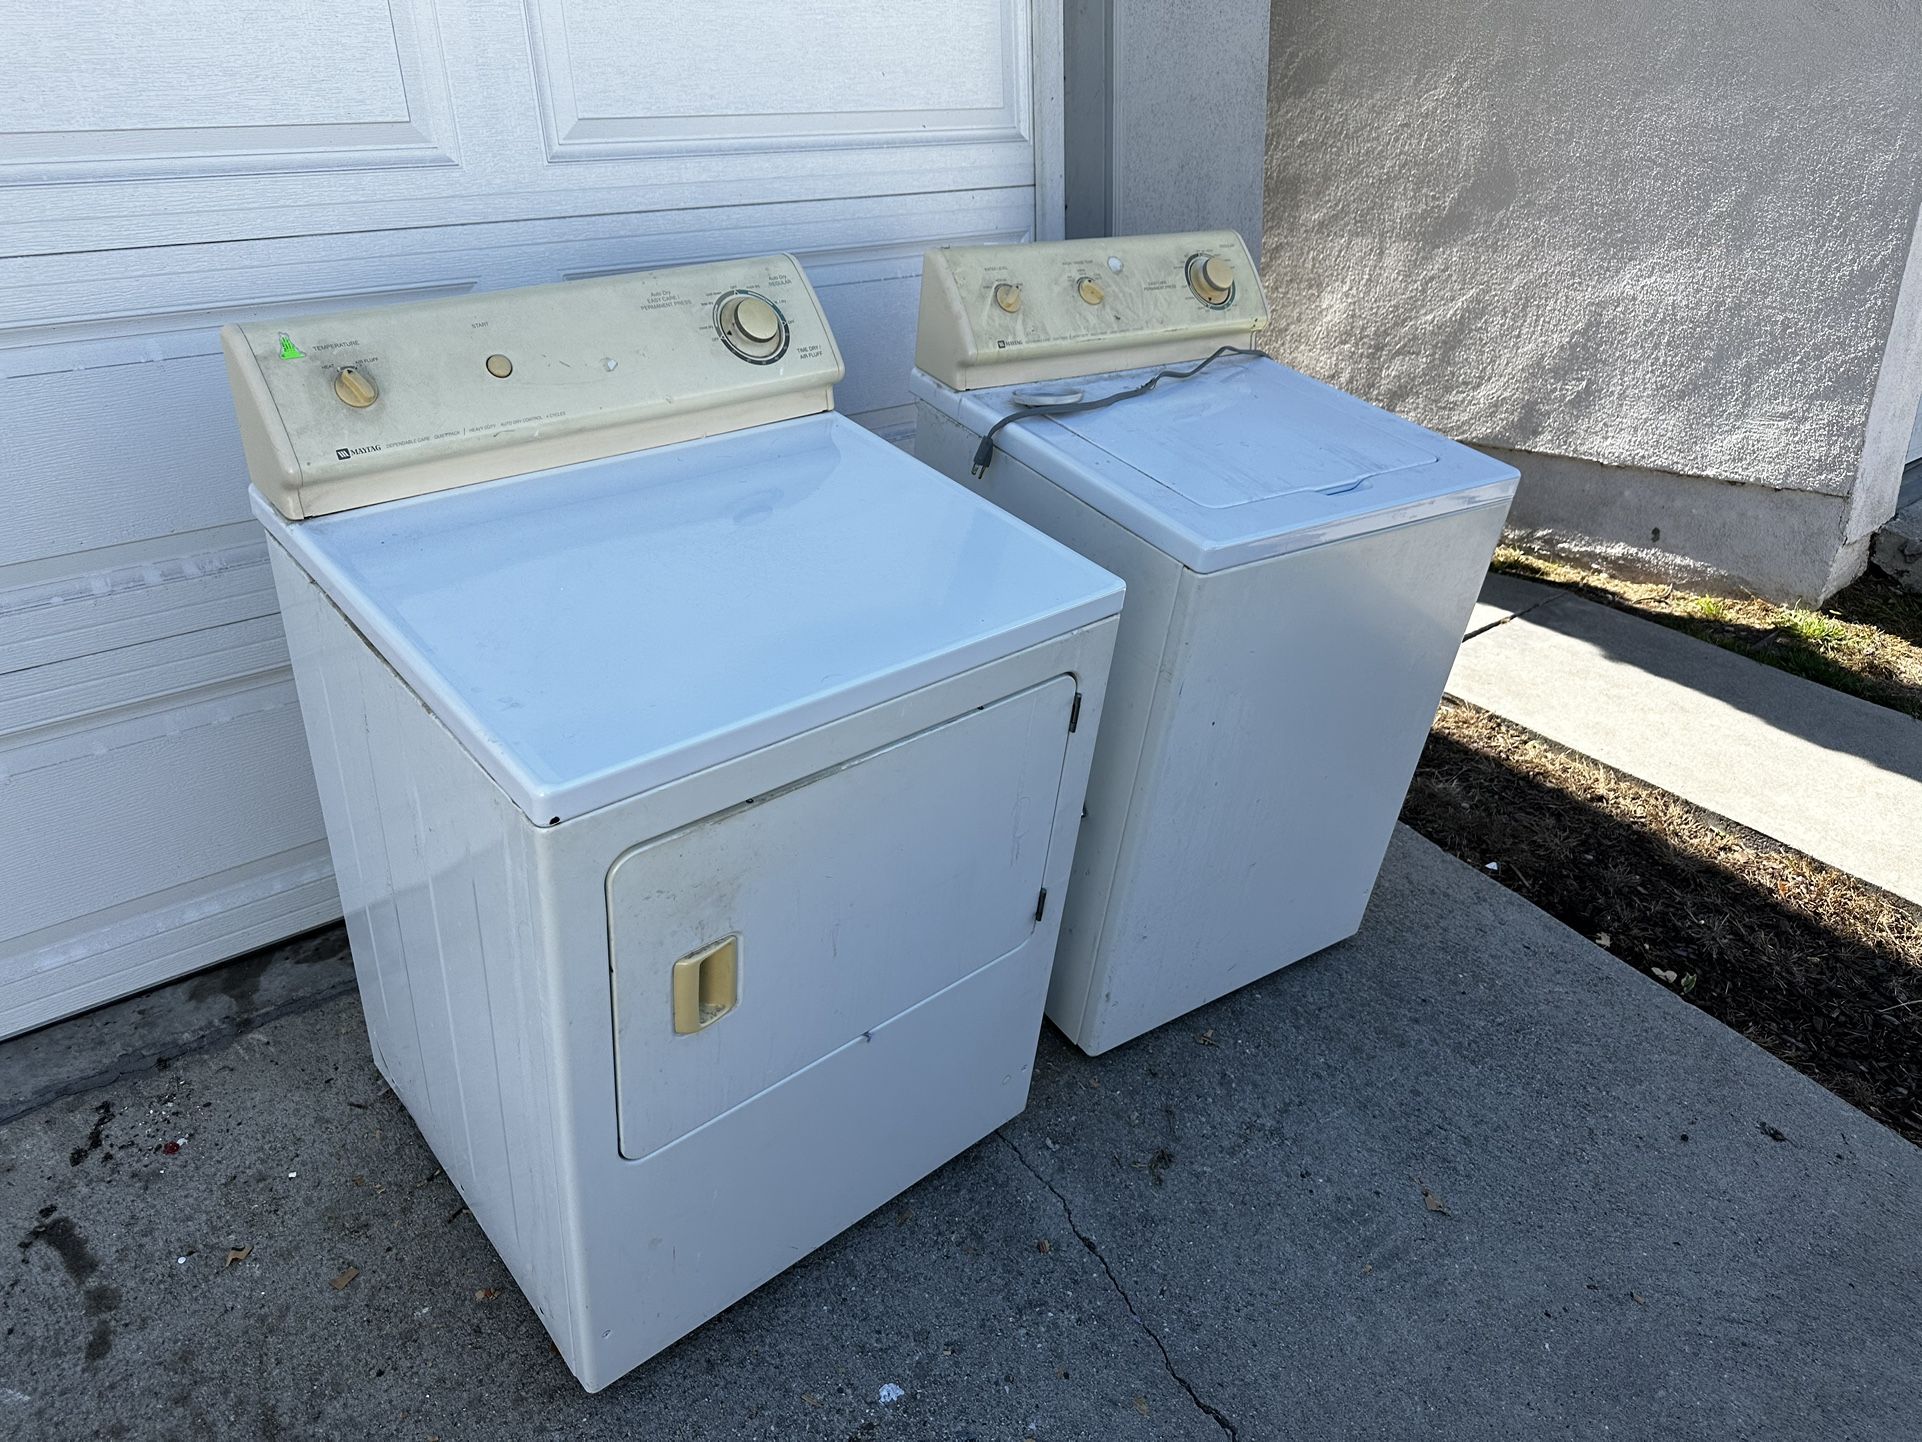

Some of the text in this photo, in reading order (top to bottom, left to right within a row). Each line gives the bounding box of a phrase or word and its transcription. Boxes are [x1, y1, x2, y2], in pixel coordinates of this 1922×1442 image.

[640, 302, 672, 311] PERMANENT
[471, 321, 489, 329] START
[312, 340, 360, 352] TEMPERATURE
[809, 350, 823, 359] FLUFF
[386, 438, 417, 449] DEPENDABLE
[350, 444, 382, 457] MAYTAG
